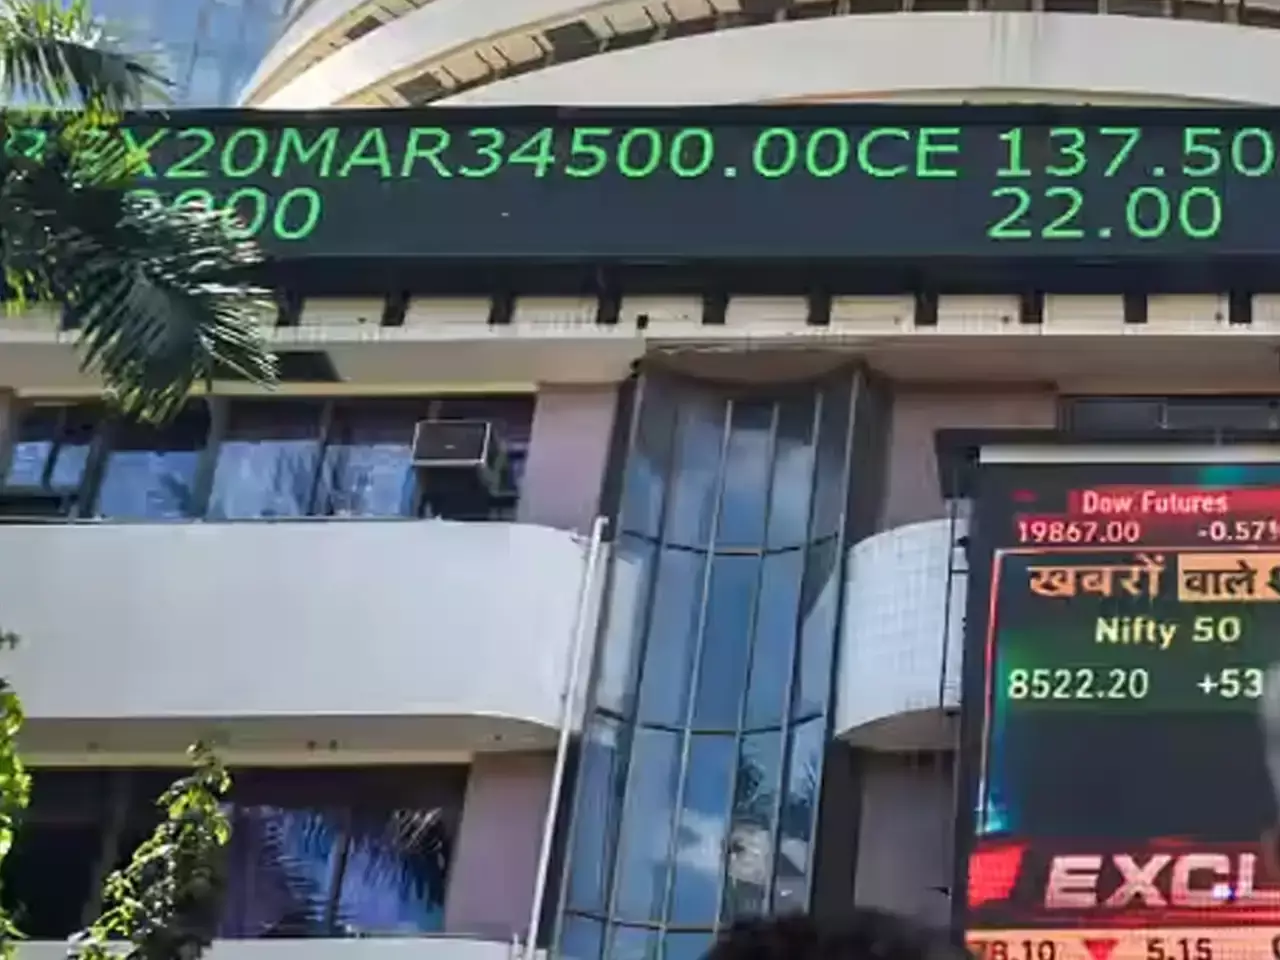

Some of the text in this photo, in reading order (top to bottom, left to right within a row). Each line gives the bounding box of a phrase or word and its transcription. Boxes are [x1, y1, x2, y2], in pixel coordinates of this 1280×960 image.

[988, 187, 1222, 238] 22.00
[1082, 490, 1229, 514] Dow Futures
[1018, 520, 1140, 543] 19867.00
[1095, 617, 1242, 650] Nifty 50
[1007, 668, 1149, 699] 8522.20
